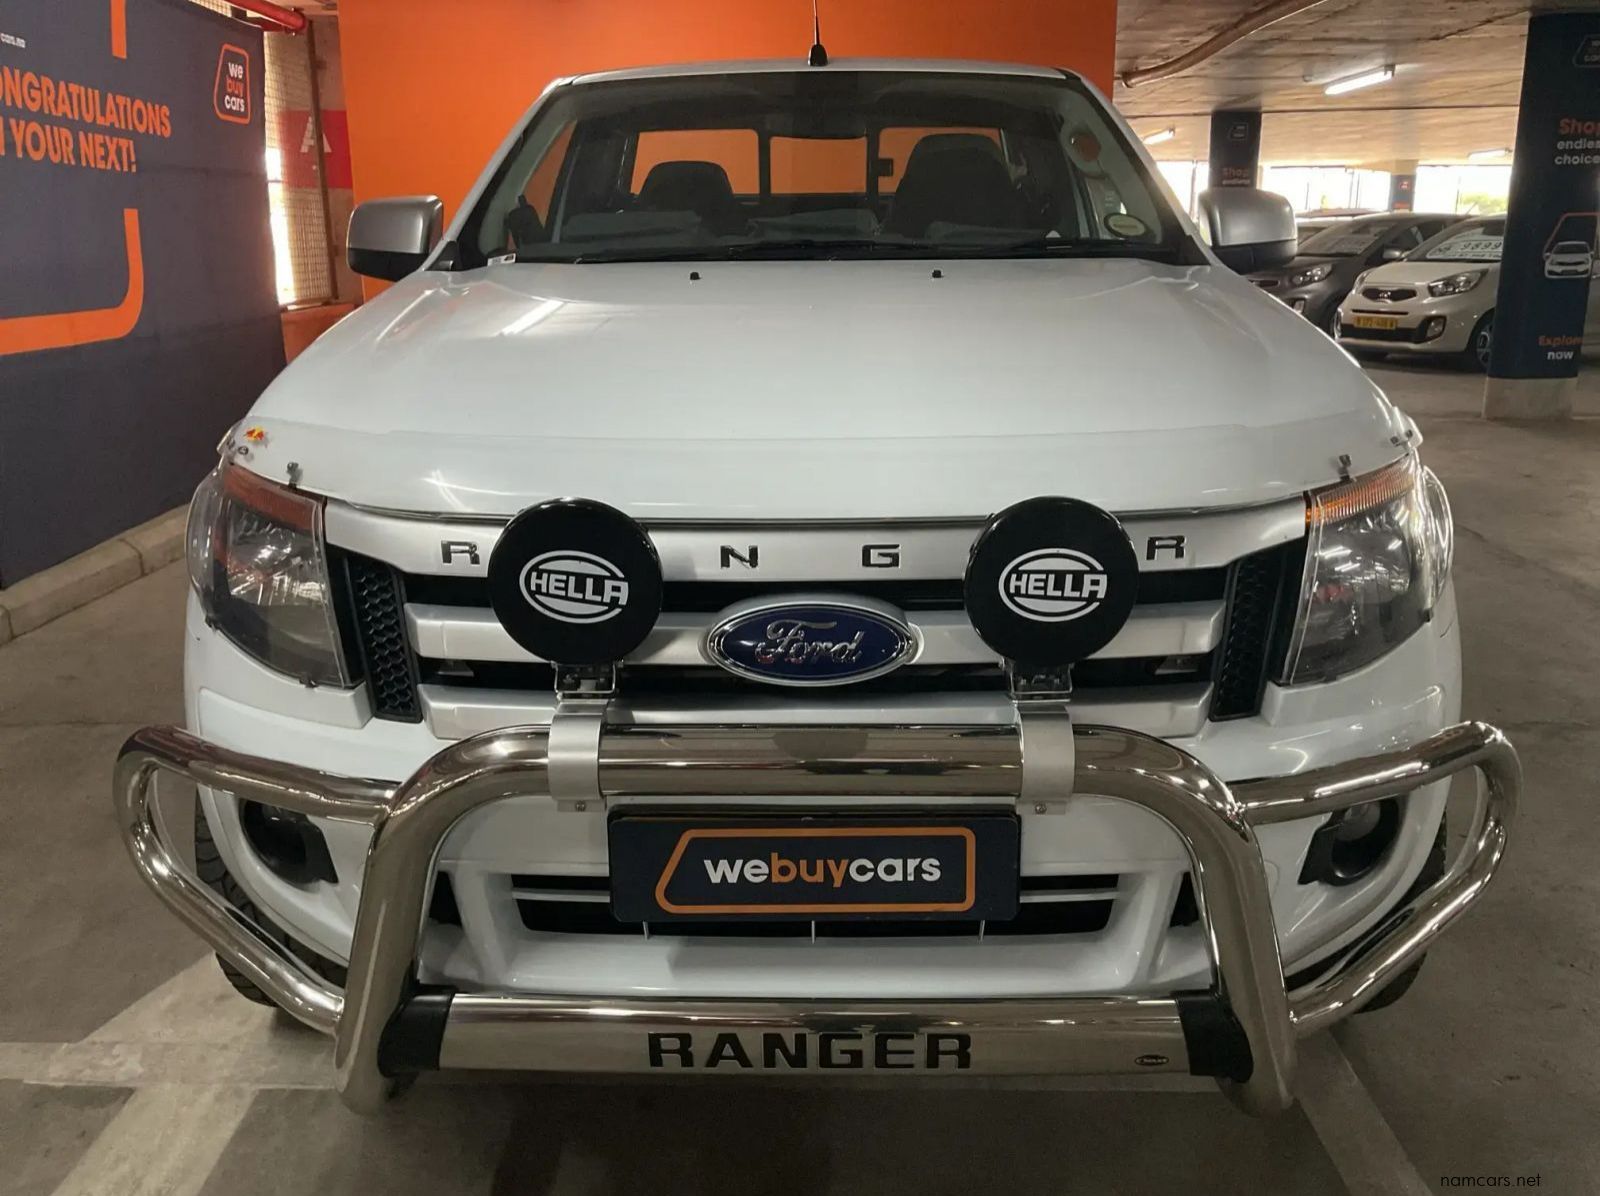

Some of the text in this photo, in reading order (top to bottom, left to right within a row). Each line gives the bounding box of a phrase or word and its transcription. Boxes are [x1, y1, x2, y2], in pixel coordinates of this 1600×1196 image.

[226, 76, 244, 97] buy
[228, 62, 243, 79] we
[0, 66, 171, 138] NGRATULATIONS
[224, 95, 245, 112] cars
[9, 117, 76, 165] YOUR
[78, 131, 137, 172] NEXT!
[1547, 351, 1574, 360] now
[530, 571, 629, 606] HELLA
[1009, 573, 1107, 599] HELLA
[755, 619, 865, 664] Ford
[703, 852, 942, 888] webuycars
[648, 1032, 972, 1069] RANGER
